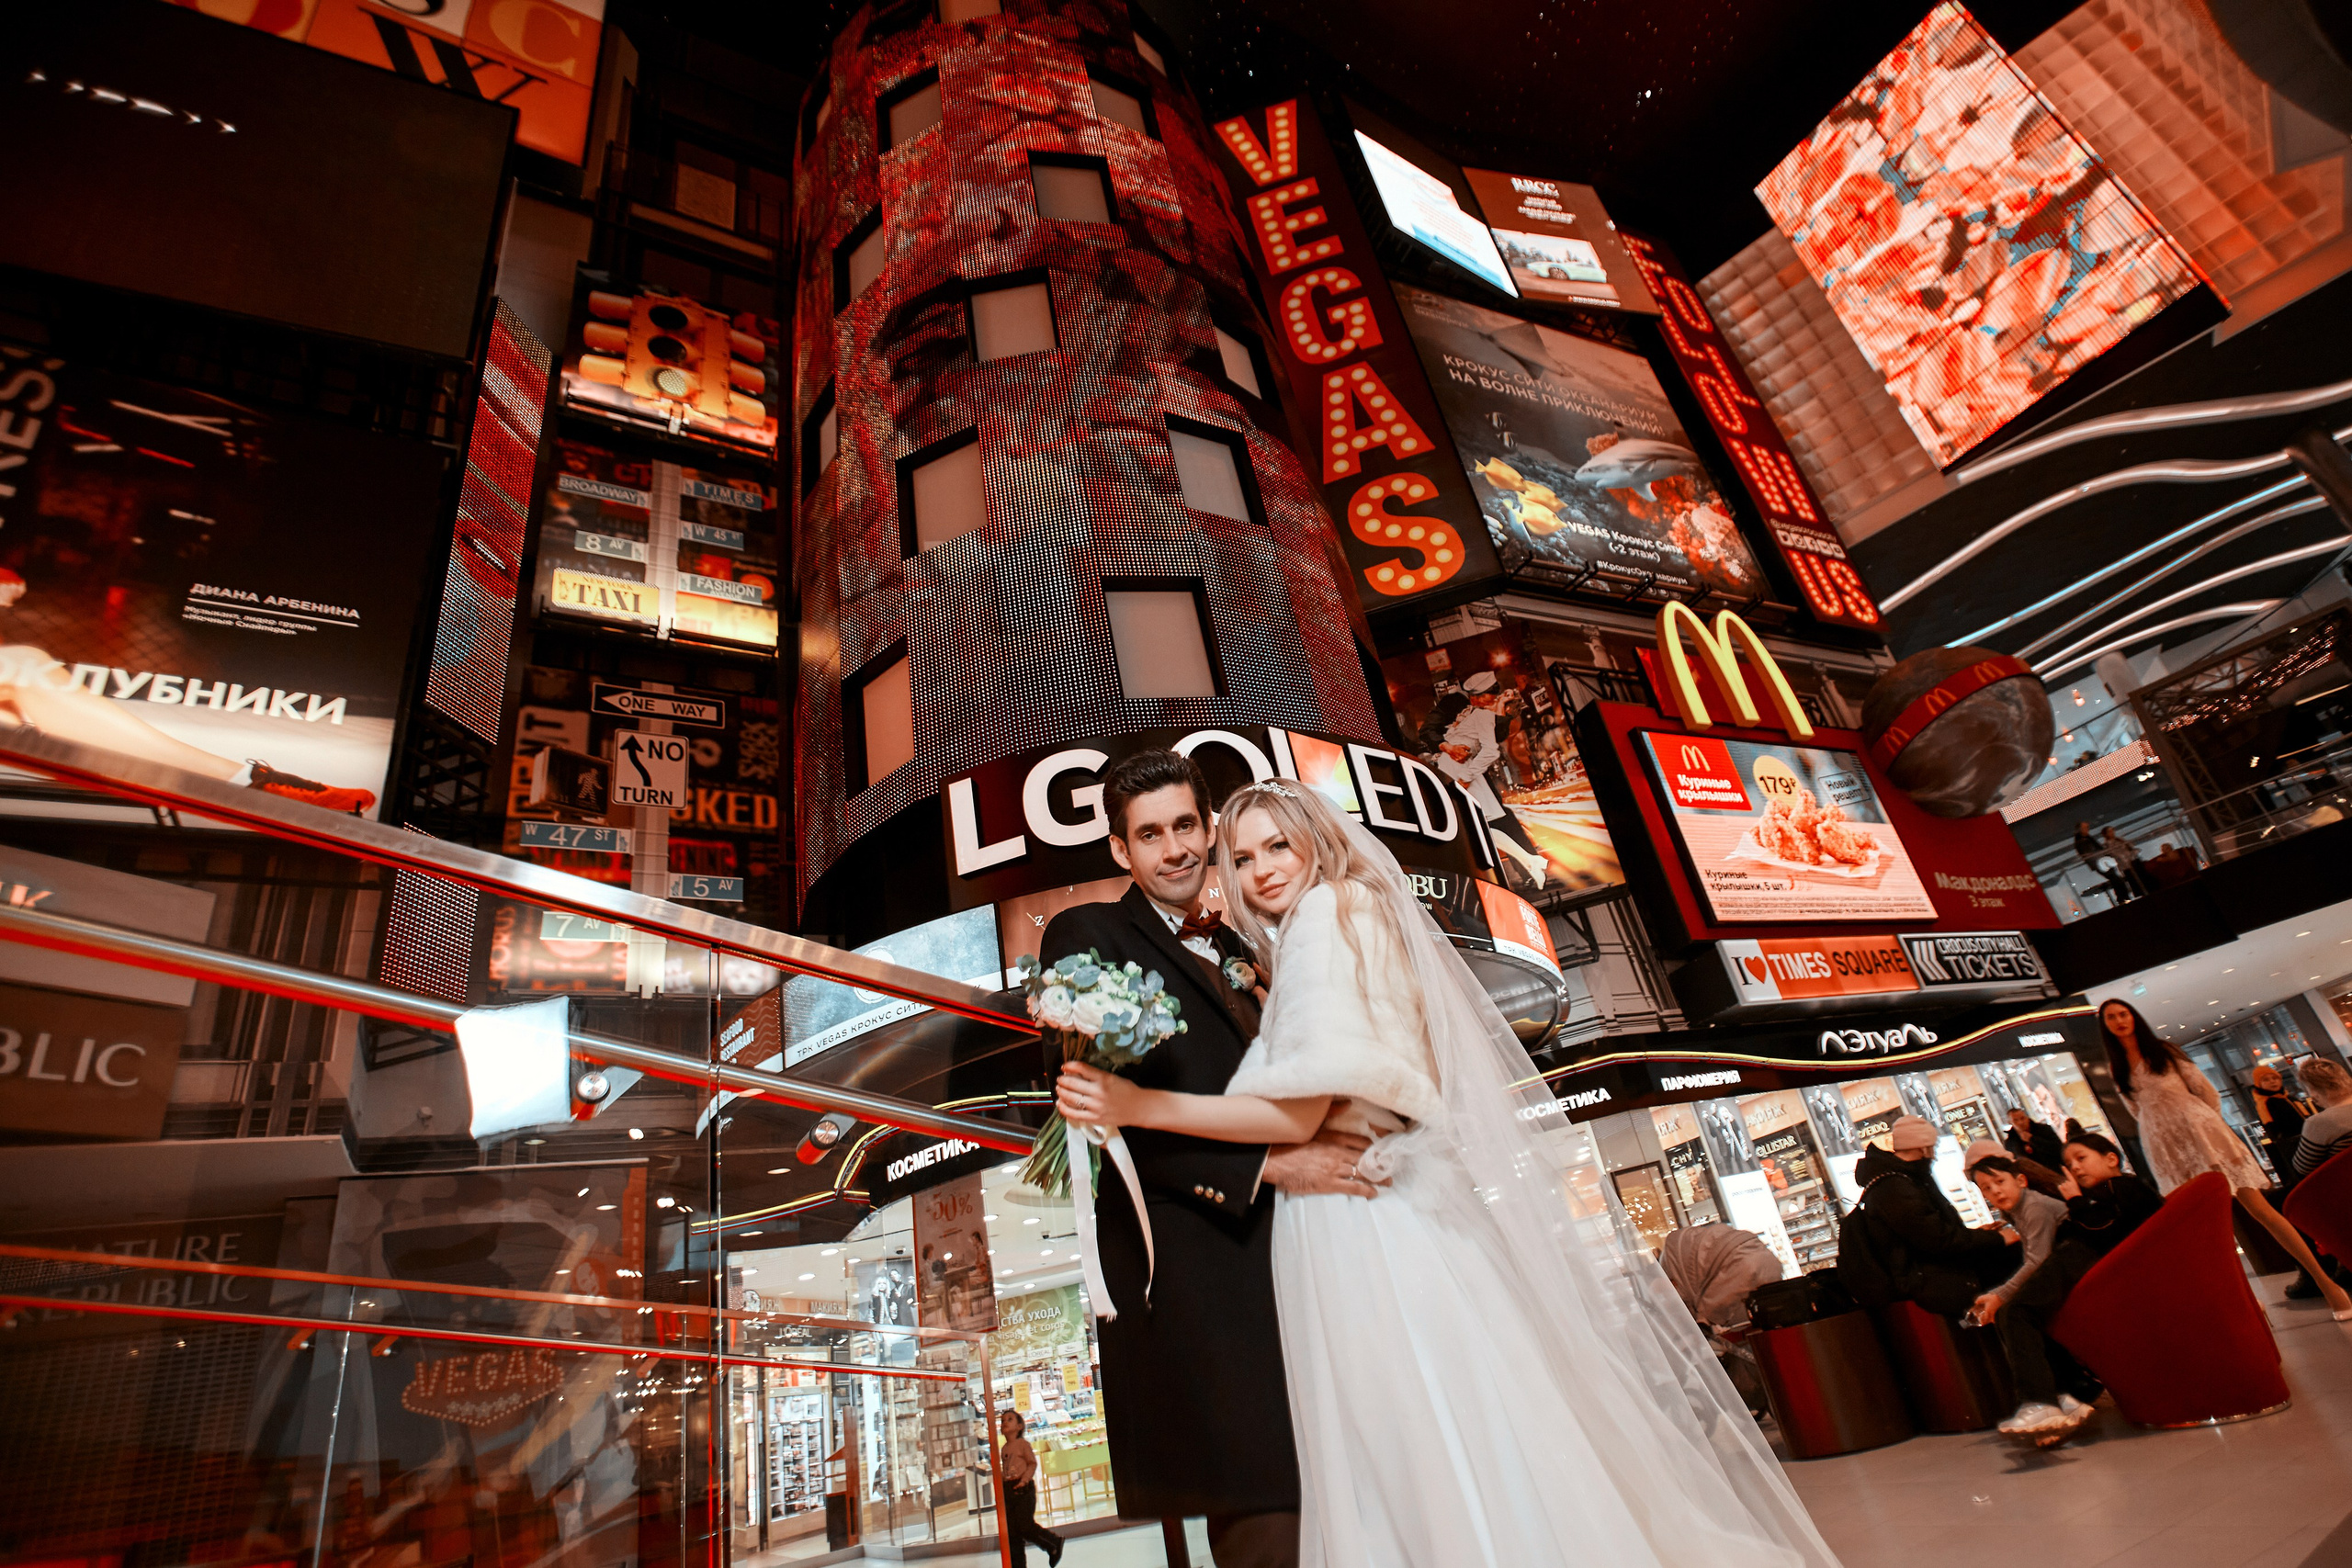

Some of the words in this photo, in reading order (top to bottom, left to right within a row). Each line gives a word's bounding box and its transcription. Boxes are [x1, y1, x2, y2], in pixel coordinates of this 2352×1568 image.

[1214, 97, 1465, 597] VEGAS
[1443, 354, 1510, 379] КРОКУС
[1514, 373, 1555, 392] СИТИ
[1561, 382, 1658, 422] ОКЕАНАРИУМ
[1450, 368, 1476, 386] НА
[1479, 376, 1539, 401] ВОЛНЕ
[1543, 393, 1666, 436] ПРИКЛЮЧЕНИЙ!
[559, 477, 639, 502] BROADWAY
[703, 484, 754, 504] TIMES
[586, 535, 601, 551] 8
[609, 539, 626, 551] AV
[694, 524, 707, 537] W
[713, 529, 727, 542] 45
[1567, 521, 1610, 539] VEGAS
[1611, 530, 1656, 549] Крокус
[1655, 540, 1684, 556] Сити
[1629, 547, 1661, 564] этаж)
[1597, 559, 1689, 585] #КрокусОкенариум
[572, 581, 640, 614] TAXI
[696, 575, 756, 599] FASHION
[1790, 552, 1879, 626] US
[190, 583, 260, 603] ДИАНА
[263, 595, 361, 620] АРБЕНИНА
[618, 695, 656, 712] ONE
[672, 702, 707, 718] WAY
[649, 739, 684, 761] NO
[1677, 773, 1732, 791] Куриные
[619, 785, 673, 807] TURN
[1677, 788, 1745, 804] крылышки
[948, 748, 1108, 877] LG
[525, 824, 539, 836] W
[548, 826, 588, 847] 47
[594, 829, 612, 842] ST
[1705, 869, 1748, 881] Куриные
[1711, 882, 1765, 892] крылышки,
[1764, 881, 1771, 890] 5
[1934, 871, 2037, 894] Макдоналдс
[693, 877, 710, 897] 5
[718, 878, 734, 892] AV
[554, 914, 576, 937] 7
[583, 919, 601, 930] AV
[1937, 939, 1977, 955] CROCUS
[1974, 938, 2000, 954] CITY
[1997, 935, 2027, 953] HALL
[1731, 956, 1753, 986] I
[1768, 952, 1832, 981] TIMES
[1832, 948, 1911, 976] SQUARE
[1945, 953, 2038, 979] TICKETS
[817, 1029, 848, 1049] VEGAS
[851, 1010, 892, 1034] КРОКУС
[2018, 1032, 2066, 1049] КОСМЕТИКА
[1660, 1070, 1742, 1092] ПАРФЮМЕРИЯ
[810, 1301, 843, 1314] МАКИЯЖ
[1028, 1306, 1062, 1323] УХОДА
[1000, 1316, 1025, 1329] СТВА
[1029, 1325, 1038, 1336] et
[1041, 1321, 1066, 1335] corps
[413, 1348, 557, 1399] VEGAS
